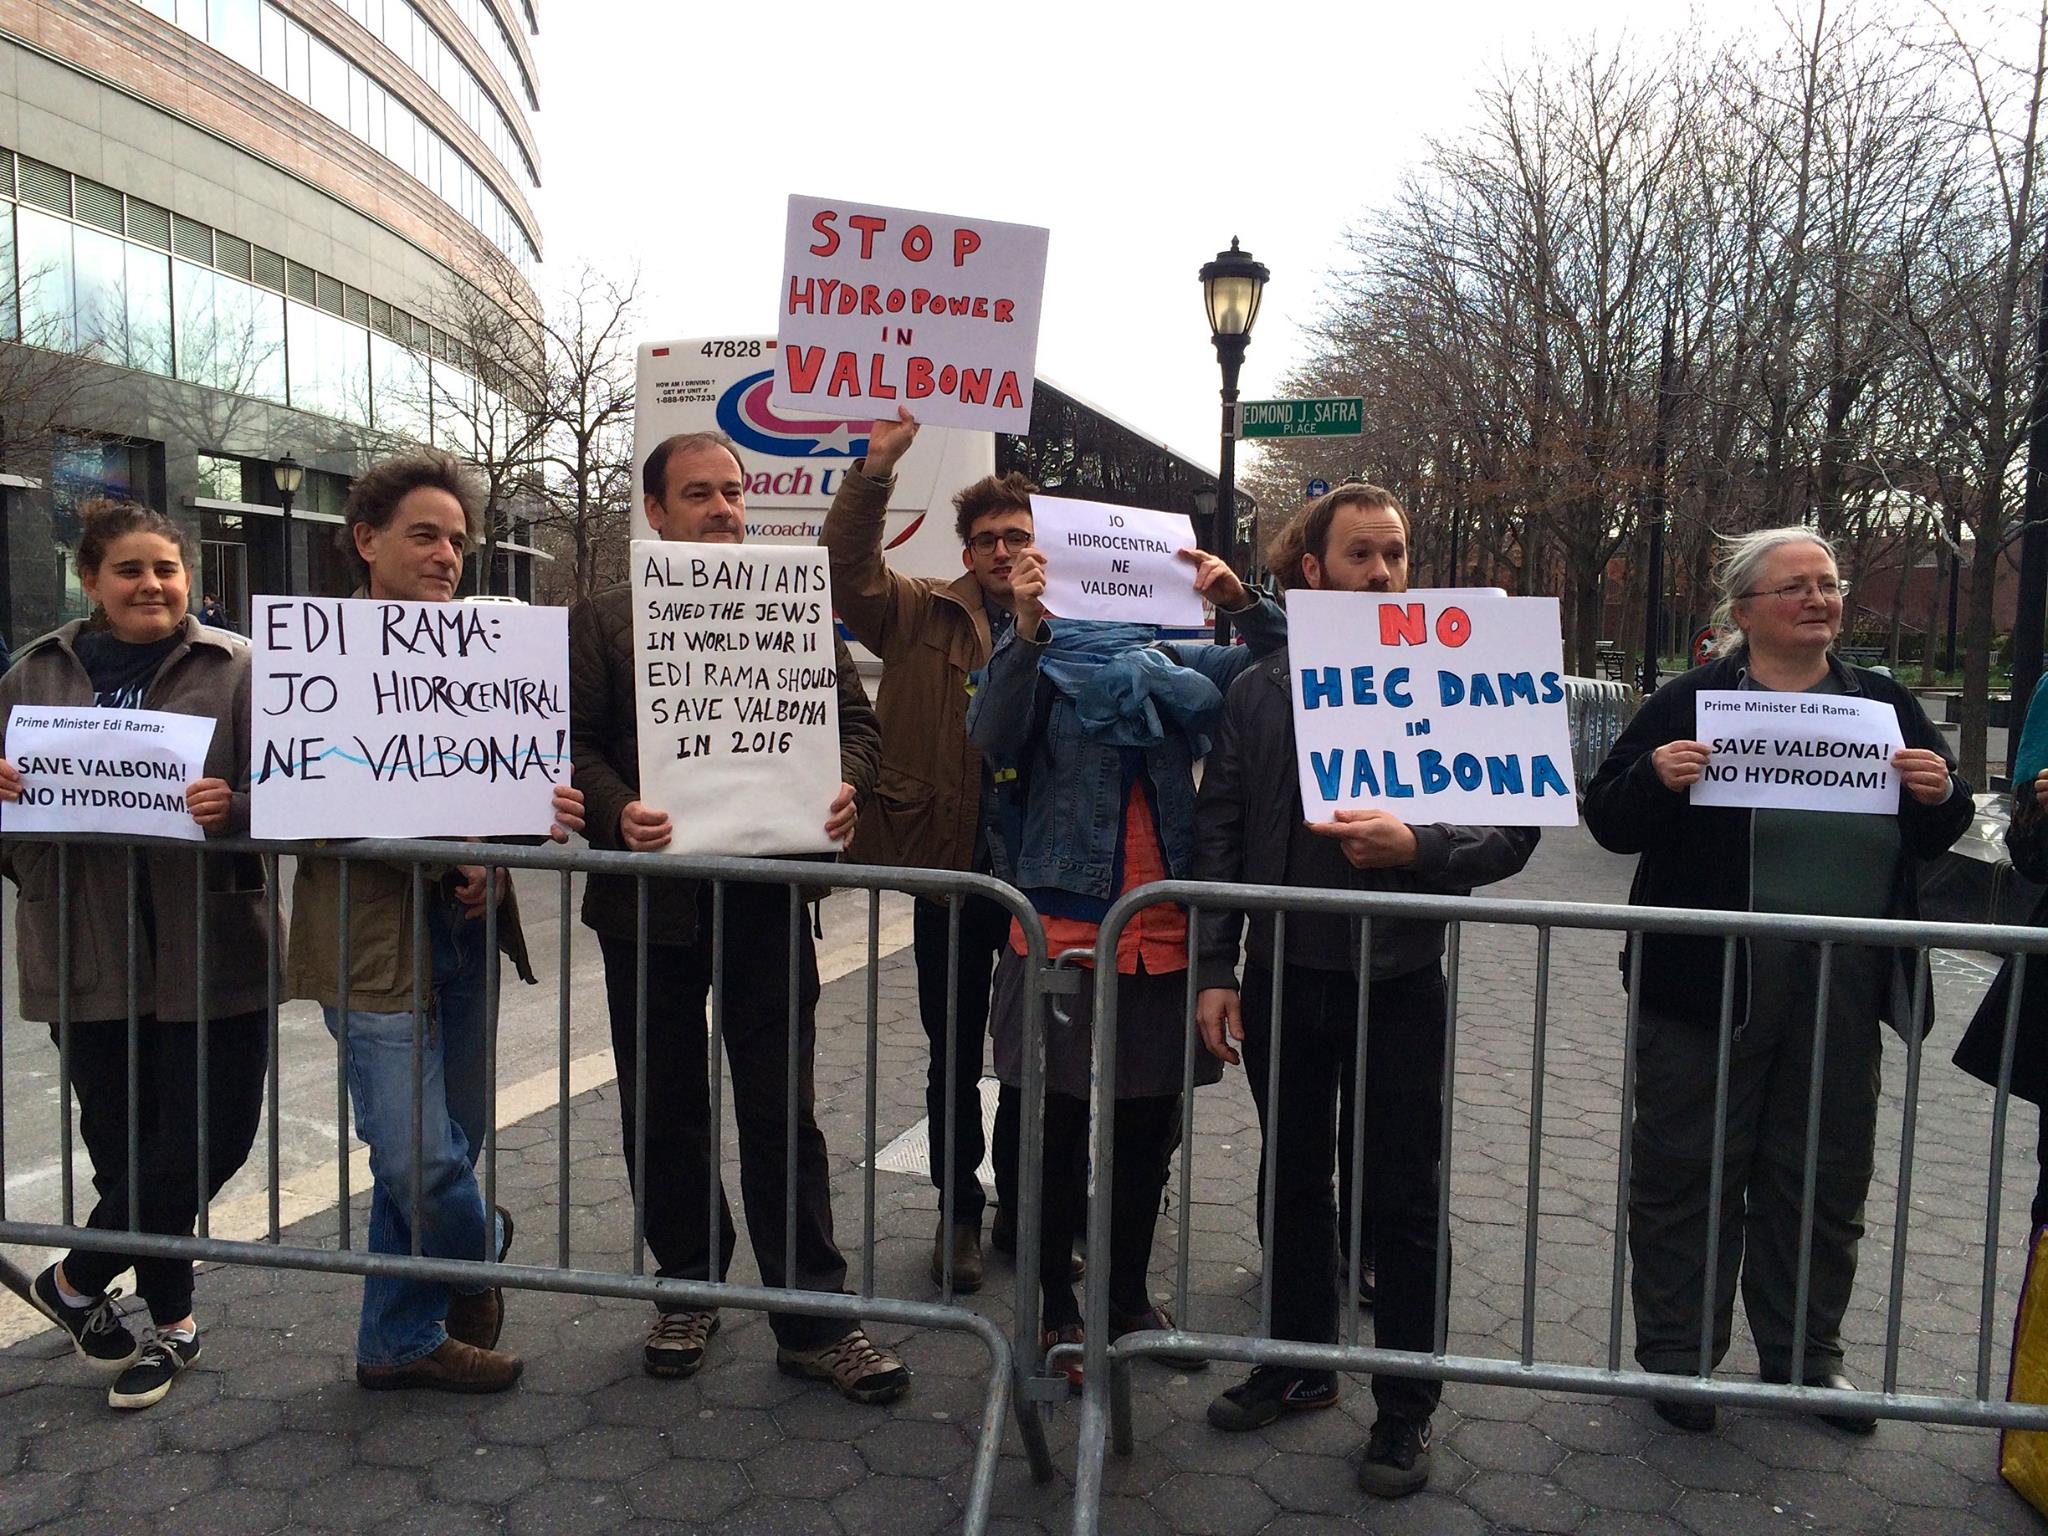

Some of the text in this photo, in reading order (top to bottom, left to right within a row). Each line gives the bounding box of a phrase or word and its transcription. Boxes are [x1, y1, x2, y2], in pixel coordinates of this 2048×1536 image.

[809, 210, 981, 267] STOP
[788, 275, 1014, 323] HYDROPOWER
[881, 326, 913, 346] IN
[701, 340, 761, 358] 47828
[785, 344, 1024, 408] VALBONA
[656, 394, 716, 404] 1-888-970-7233
[1243, 402, 1357, 424] EDMOND J. SAFRA
[1283, 423, 1317, 434] PLACE
[1109, 515, 1124, 528] JO
[1068, 533, 1171, 553] HIDROCENTRAL
[645, 556, 826, 593] ALBANIANS
[1111, 560, 1130, 573] NE
[1081, 580, 1153, 598] VALBONA!
[648, 601, 820, 624] SAVED THE JEWS
[267, 602, 502, 658] EDI RAMA:
[1378, 603, 1472, 648] NO
[647, 631, 816, 653] IN WORLD WAR II
[648, 662, 837, 692] EDI RAMA SHOULD
[1301, 666, 1565, 710] HEC DAMS
[263, 670, 566, 720] JO HIDROCENTRAL
[651, 697, 826, 725] SAVE VALBONA
[1704, 701, 1860, 716] Prime Minister Edi Rama:
[15, 717, 165, 734] Prime Minister Edi Rama:
[1406, 718, 1431, 736] IN
[677, 731, 793, 759] IN 2016
[1711, 738, 1889, 761] SAVE VALBONA!
[257, 729, 566, 785] NE VALBONA!
[18, 757, 187, 782] SAVE VALBONA!
[1310, 748, 1570, 801] VALBONA
[1704, 765, 1887, 789] NO HYDRODAM!
[18, 787, 55, 806] NO
